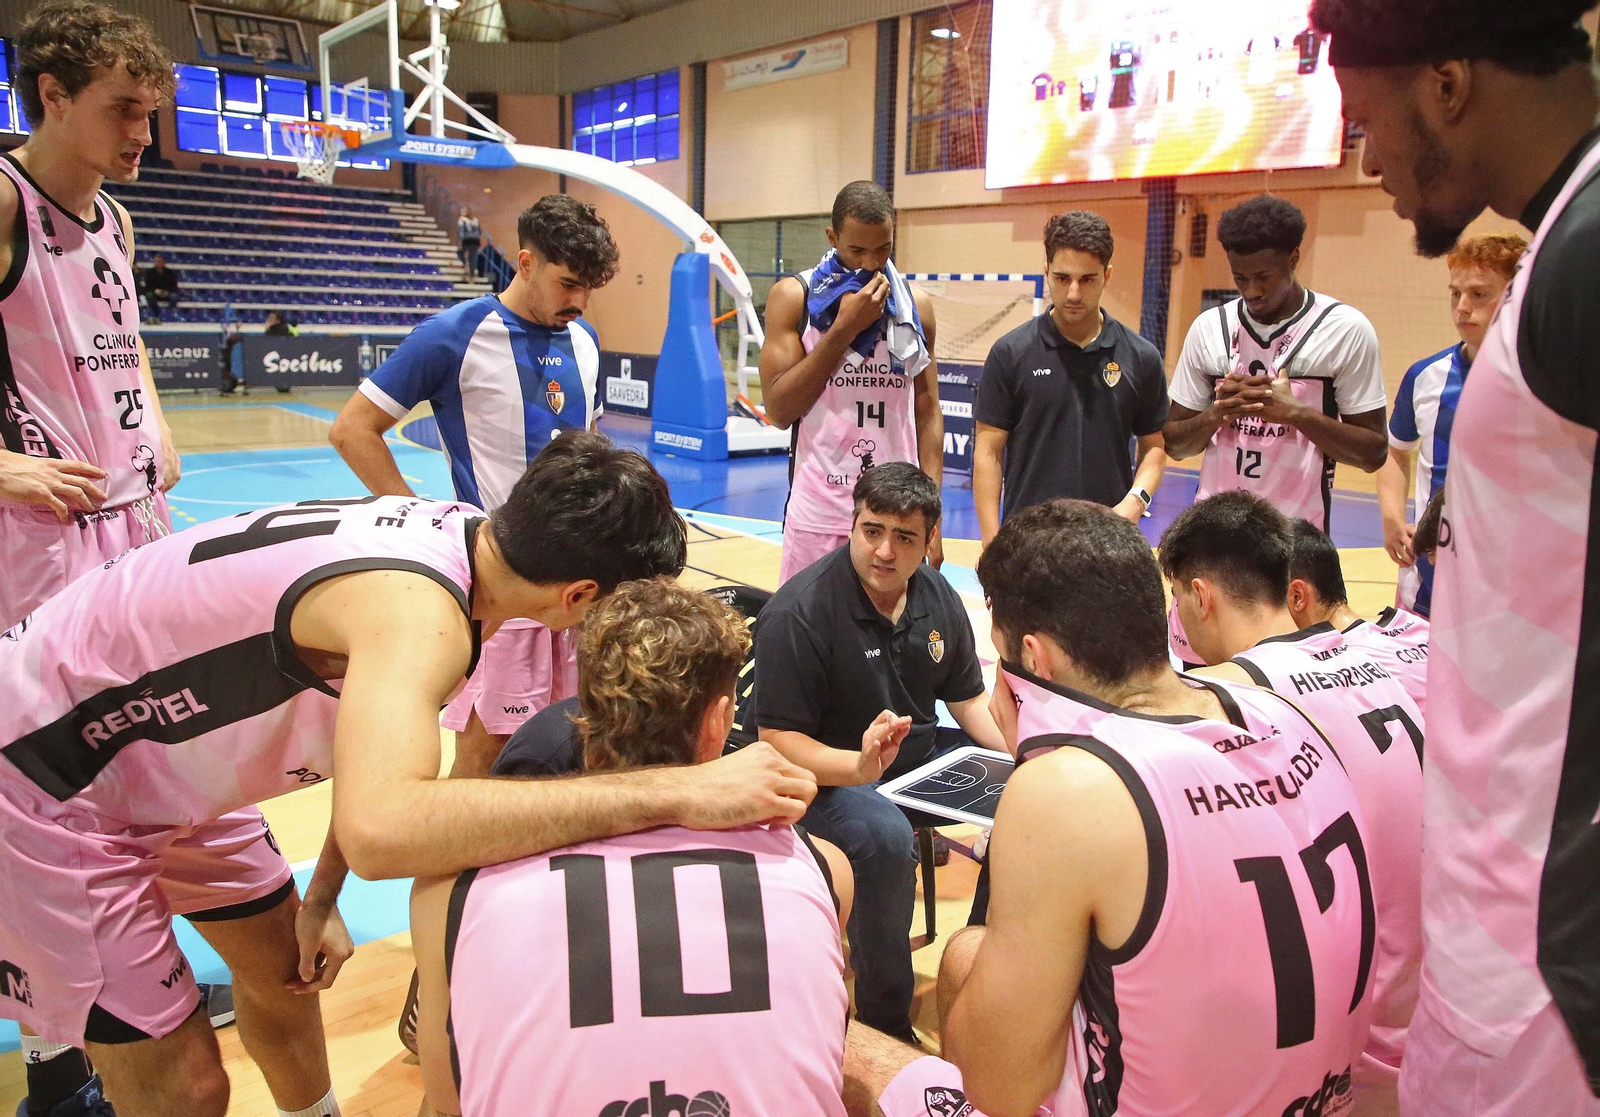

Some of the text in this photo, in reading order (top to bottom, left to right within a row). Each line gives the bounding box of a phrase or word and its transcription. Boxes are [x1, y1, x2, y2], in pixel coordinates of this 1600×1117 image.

[537, 355, 562, 366] vive
[856, 401, 885, 428] 14
[1236, 447, 1262, 478] 12
[826, 473, 851, 486] cat
[503, 705, 529, 714] vive
[1357, 704, 1425, 776] 7
[549, 848, 772, 1029] 10
[1234, 811, 1376, 1050] 17
